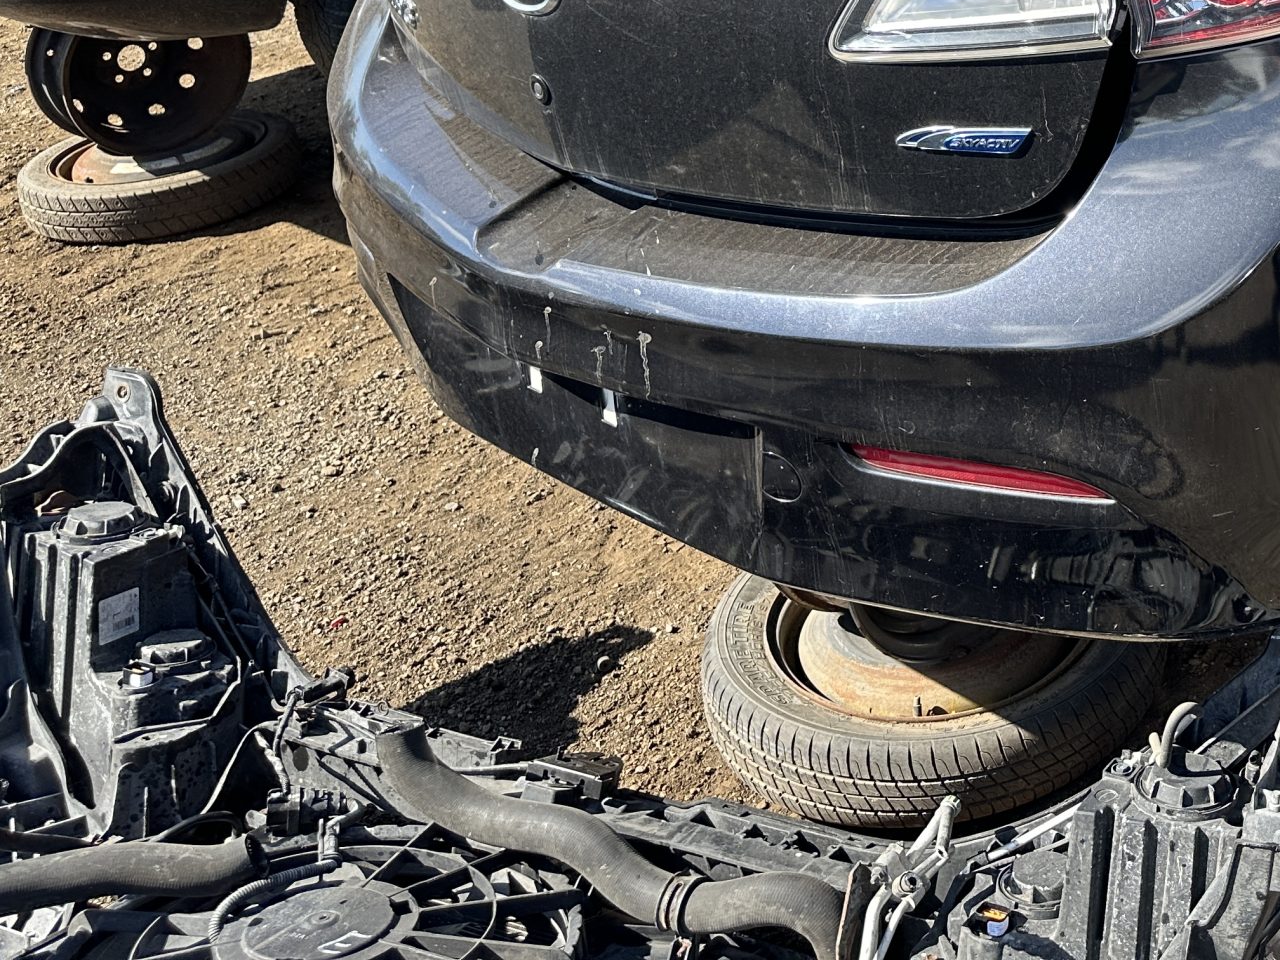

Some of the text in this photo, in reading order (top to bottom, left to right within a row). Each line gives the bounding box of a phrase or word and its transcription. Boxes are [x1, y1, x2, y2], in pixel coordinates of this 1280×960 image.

[949, 138, 1020, 149] SKYACTIV
[731, 601, 755, 645] TIRE
[734, 649, 789, 705] SPARE
